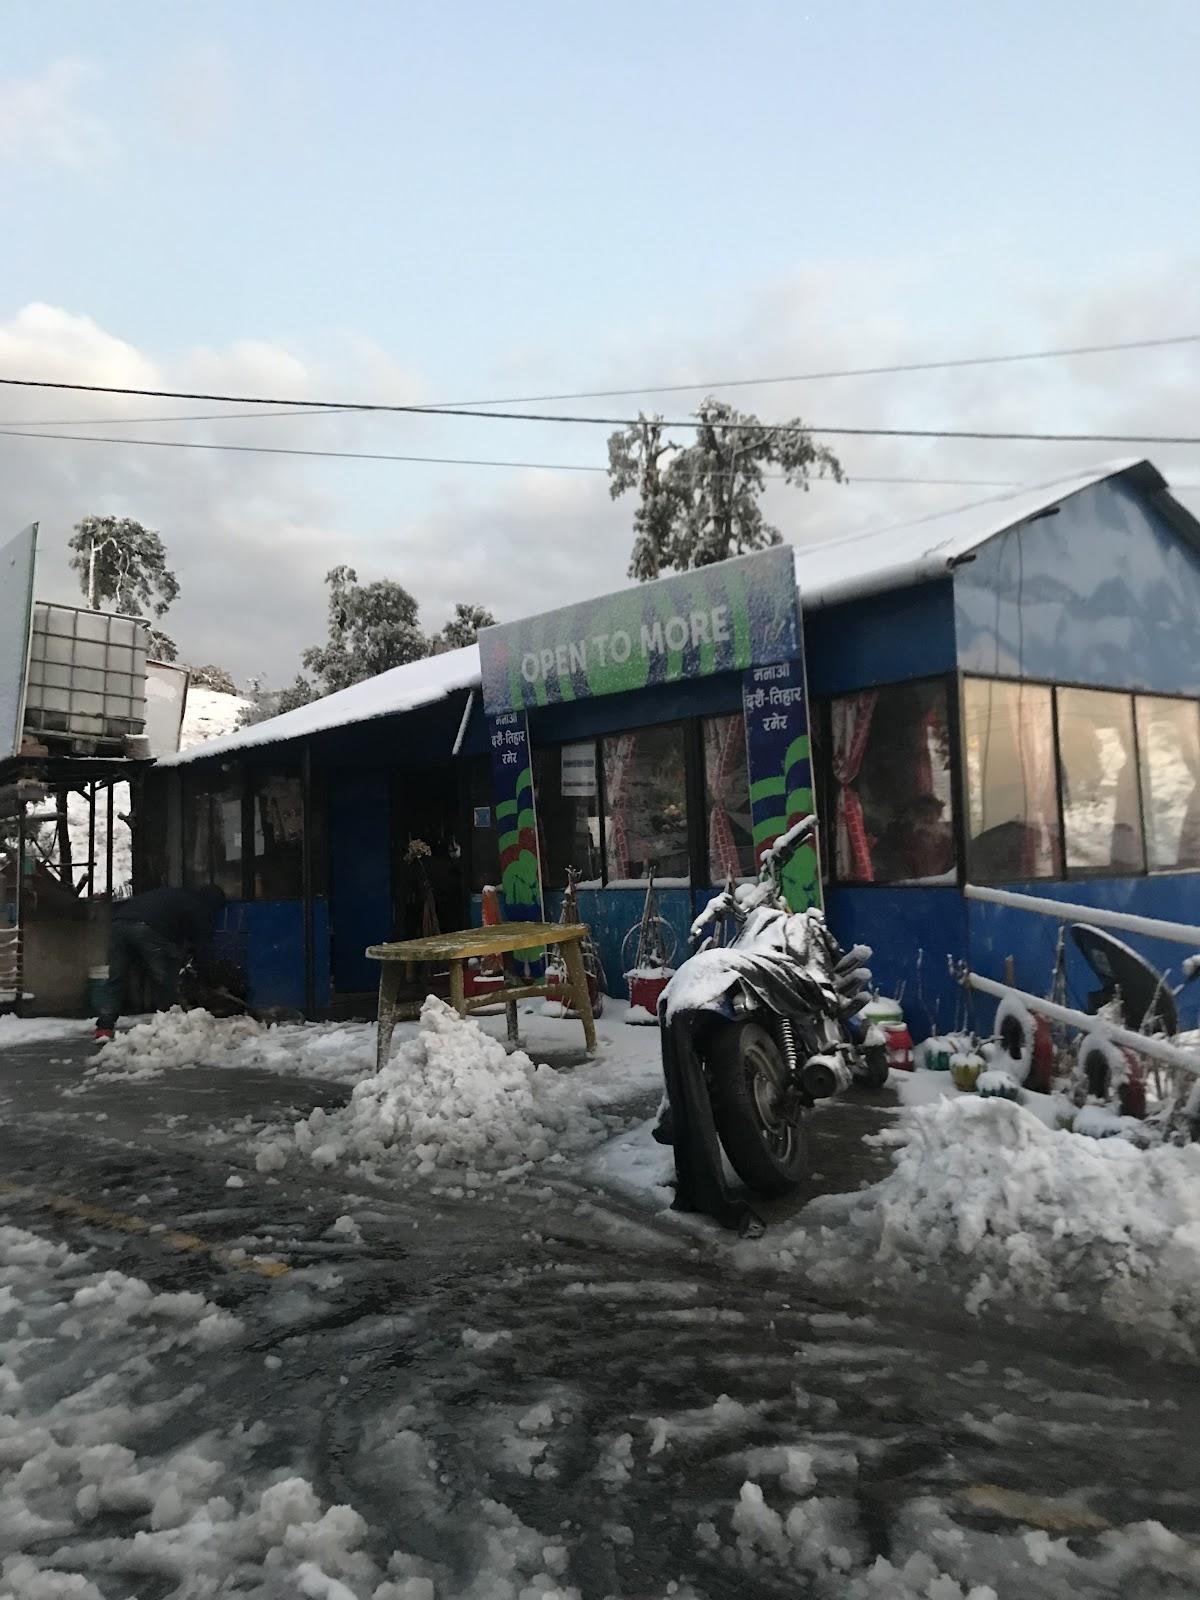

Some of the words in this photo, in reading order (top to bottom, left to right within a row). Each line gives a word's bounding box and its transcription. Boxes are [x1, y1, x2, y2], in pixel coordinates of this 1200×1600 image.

[521, 639, 587, 683] OPEN
[592, 630, 631, 667] TO
[640, 605, 730, 658] MORE
[762, 712, 788, 731] रमेर
[501, 750, 517, 764] रमेर
